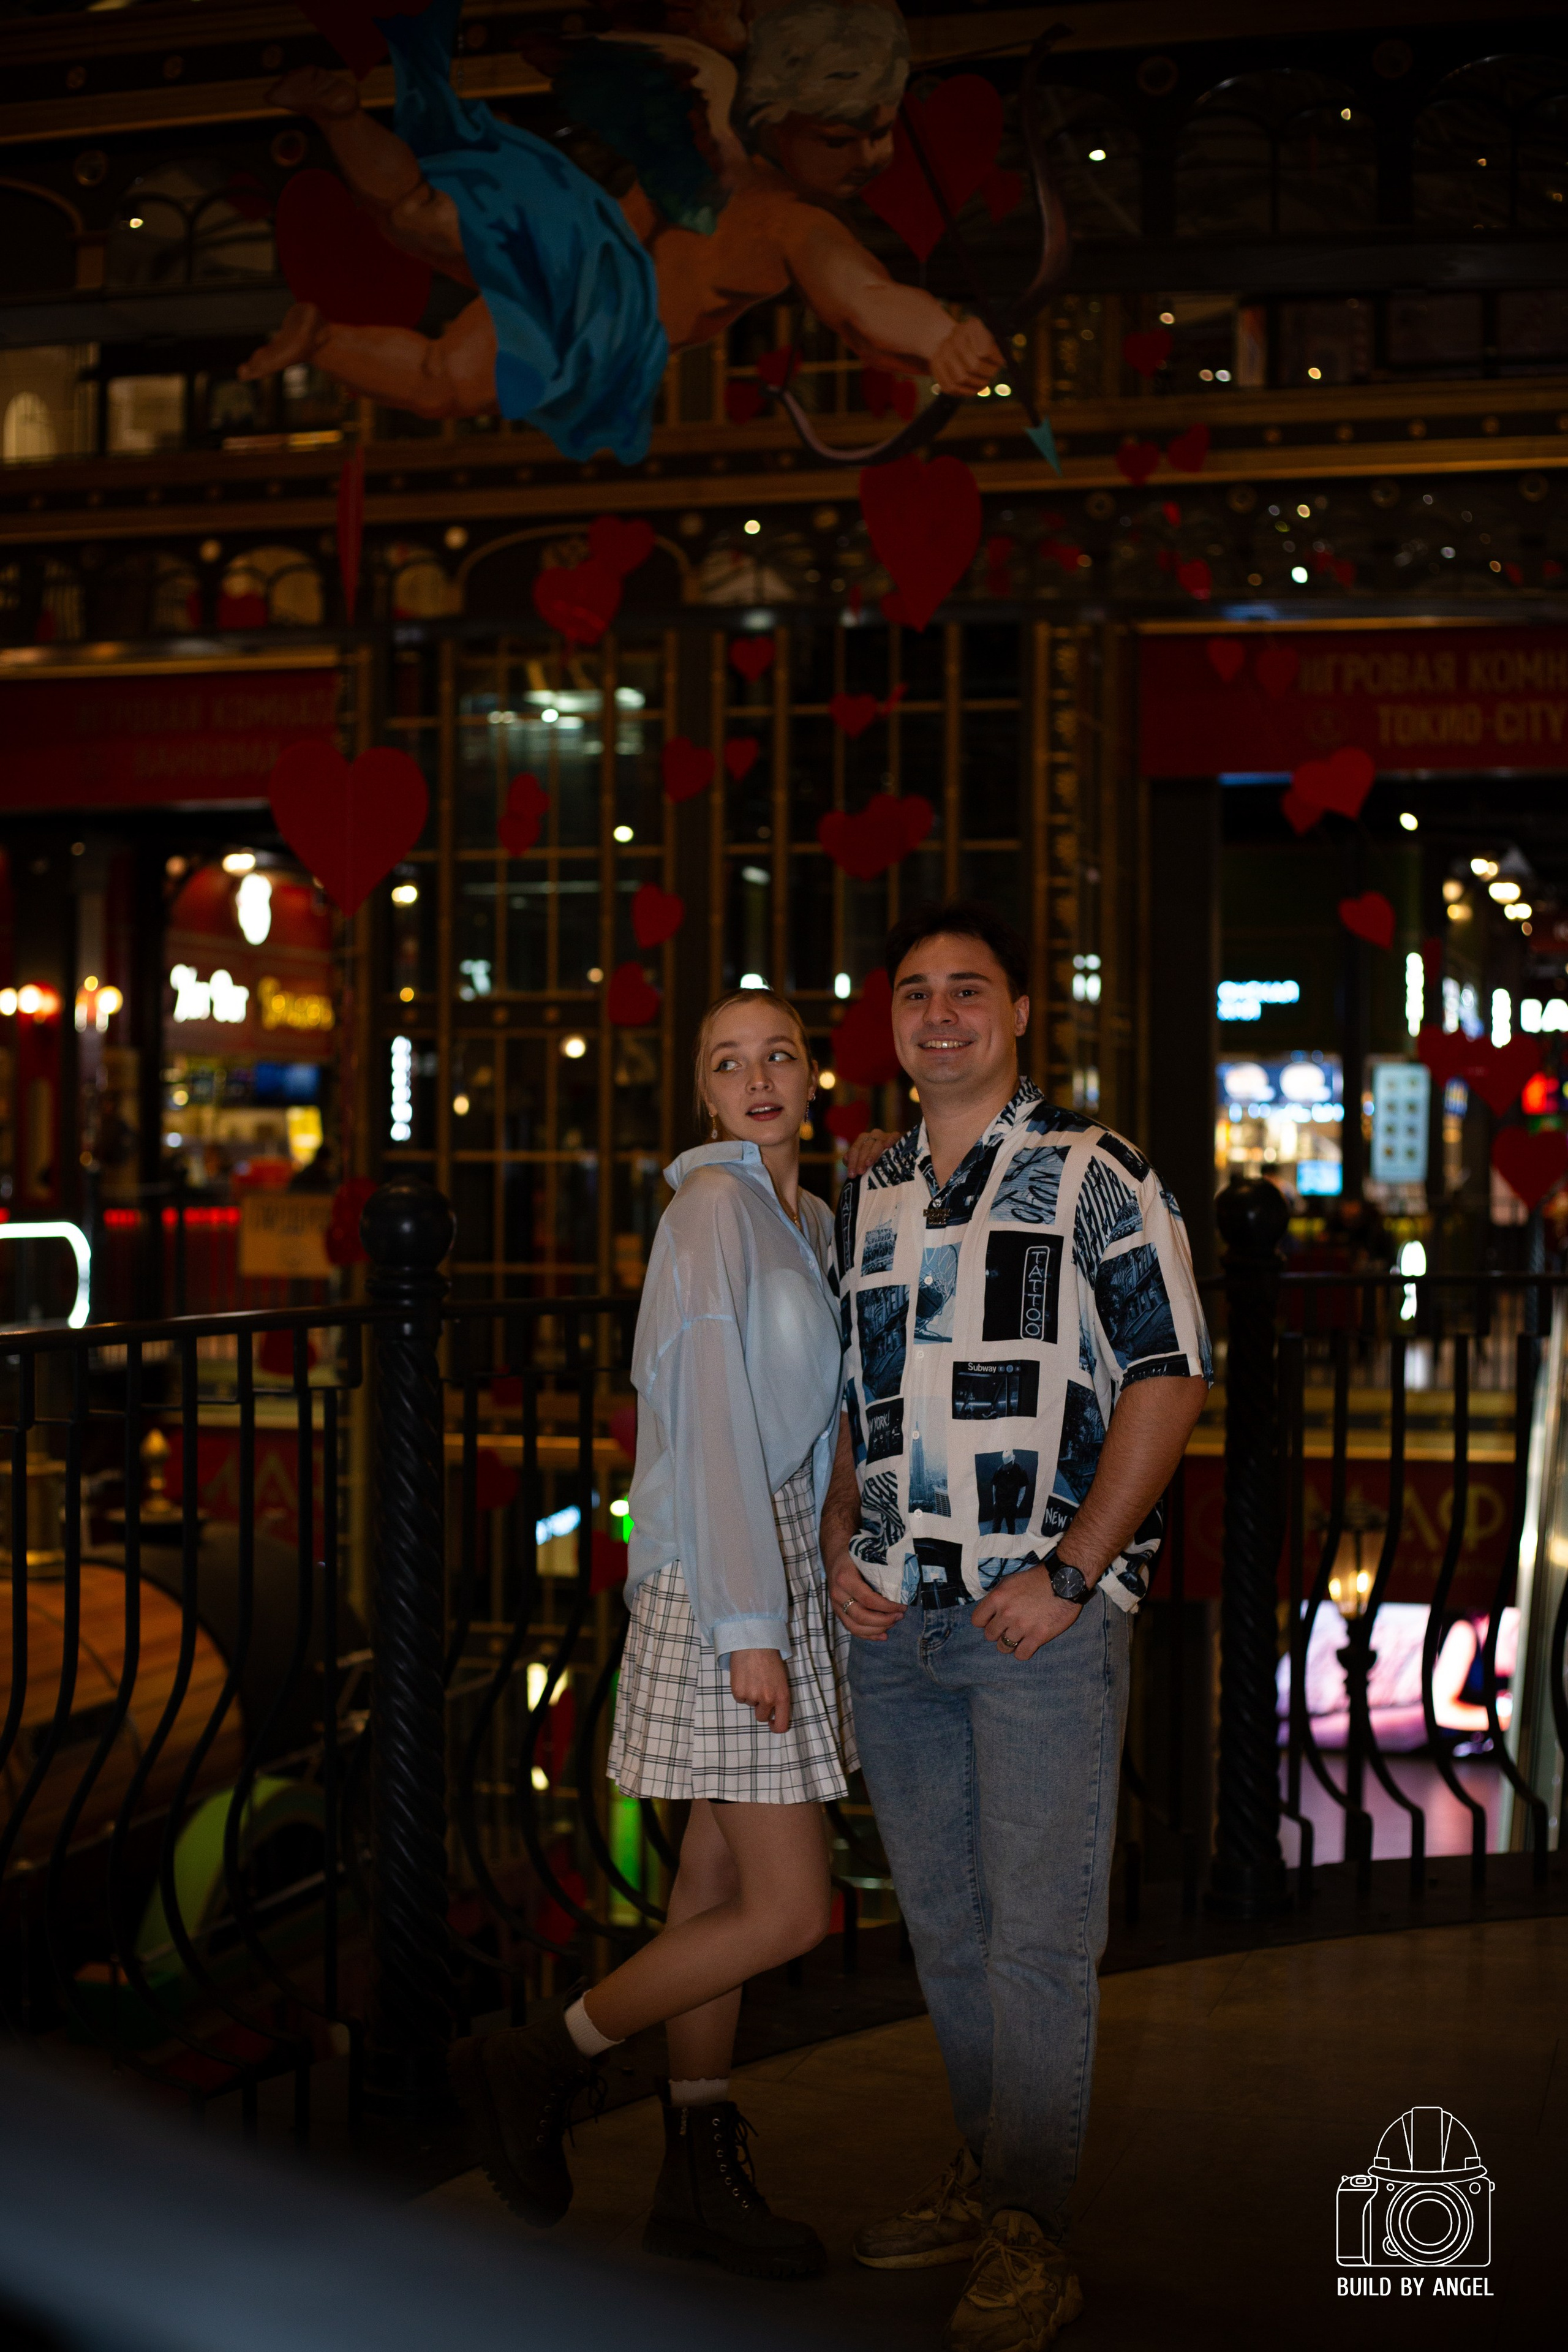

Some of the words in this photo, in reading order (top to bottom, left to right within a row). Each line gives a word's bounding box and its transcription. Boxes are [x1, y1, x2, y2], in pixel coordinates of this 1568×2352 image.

[1025, 1251, 1047, 1336] TATTOO
[968, 1362, 997, 1373] Subway
[1044, 1507, 1068, 1529] NEW
